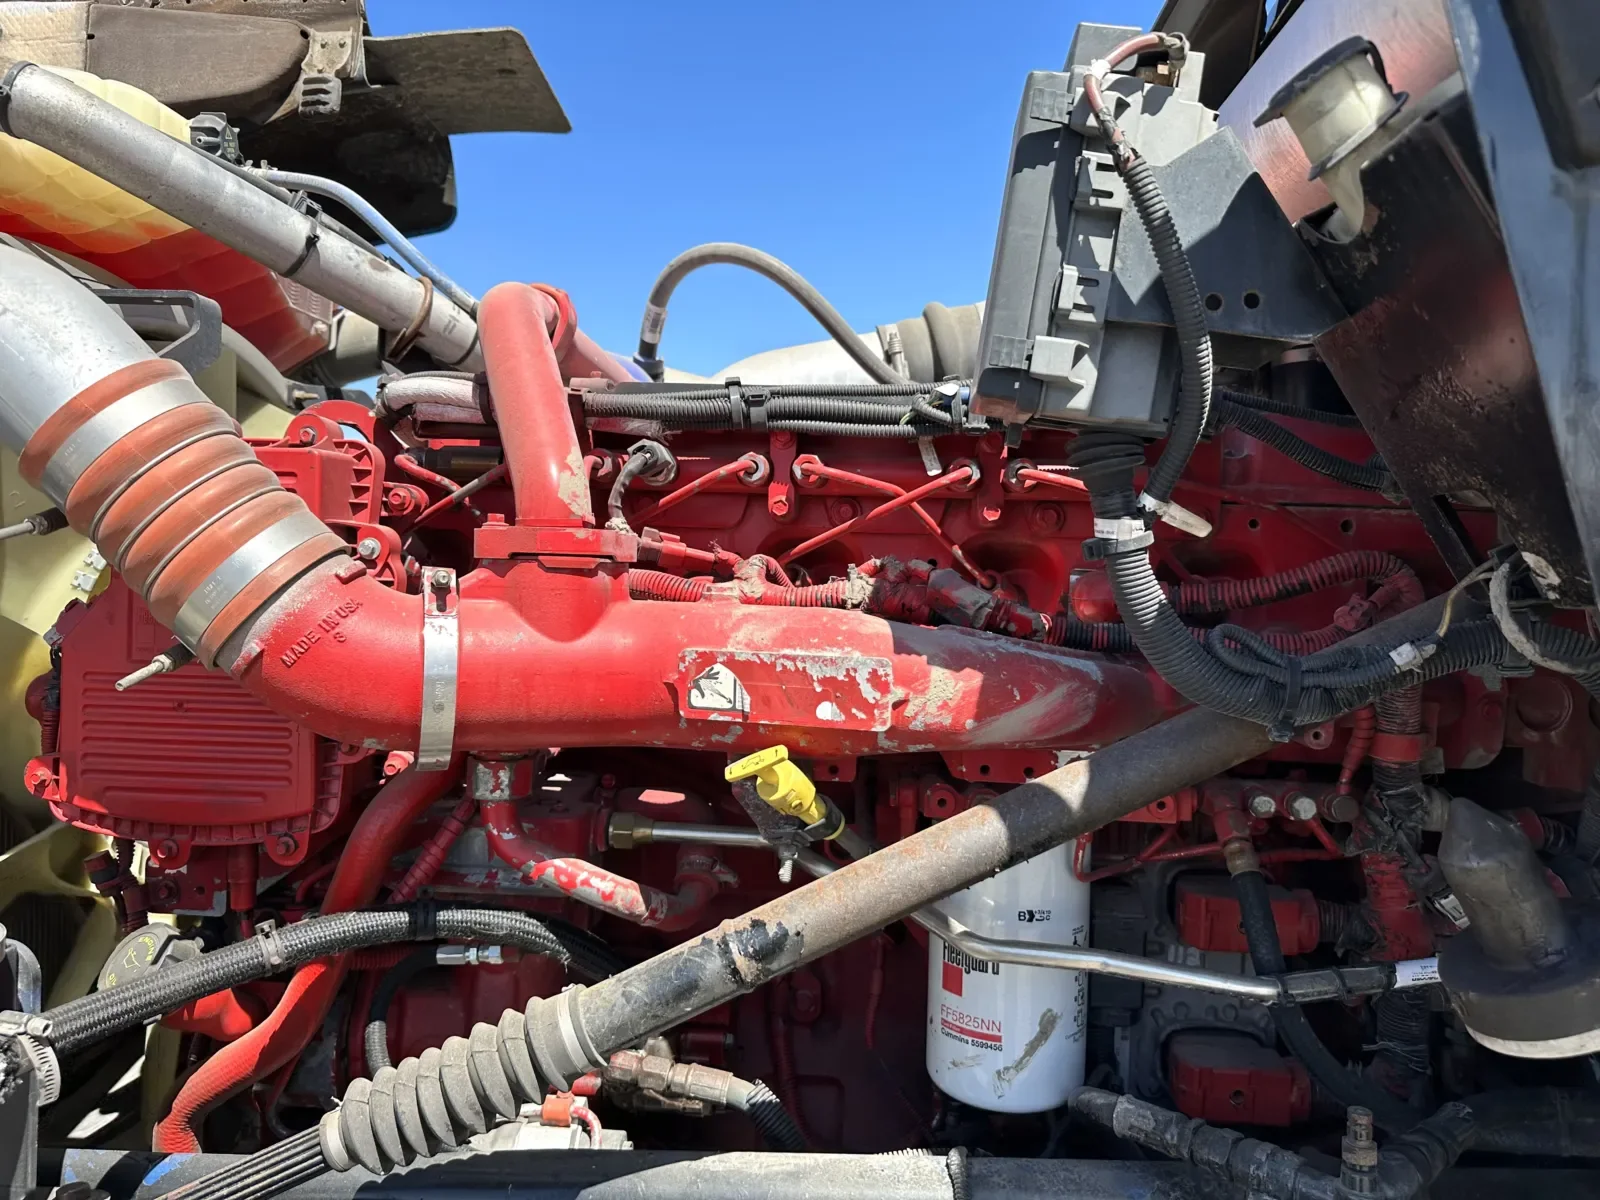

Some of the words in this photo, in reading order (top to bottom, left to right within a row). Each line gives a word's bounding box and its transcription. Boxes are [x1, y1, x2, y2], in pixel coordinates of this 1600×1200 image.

[280, 630, 321, 668] MADE
[317, 614, 340, 633] IN
[138, 936, 155, 961] ENGINE
[940, 1004, 1002, 1033] FF5825NN
[940, 1027, 969, 1045] Cummins
[970, 1040, 1003, 1052] 5599456
